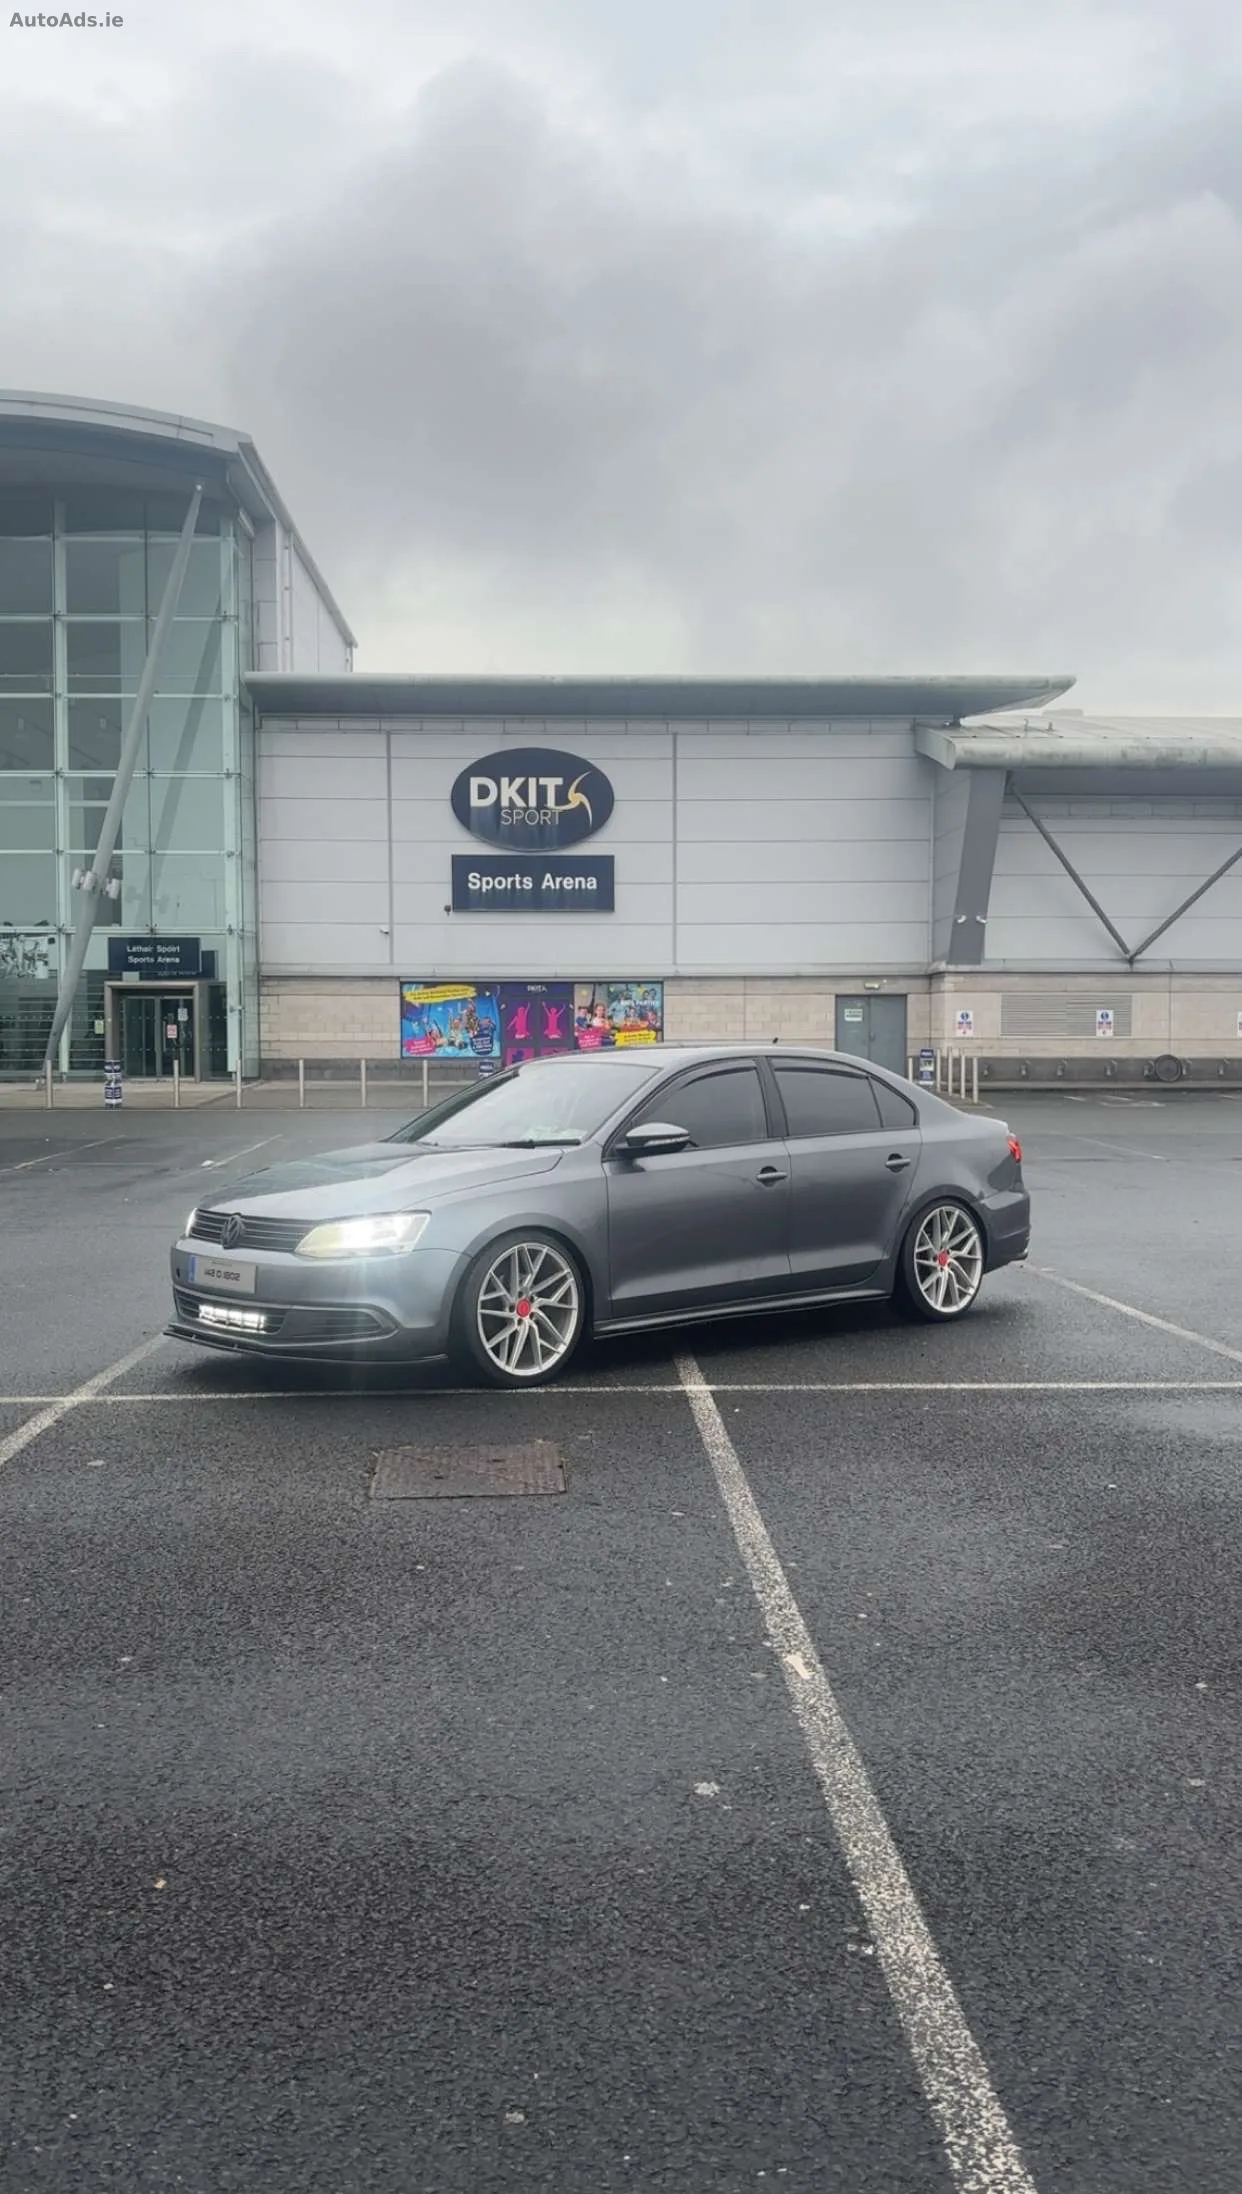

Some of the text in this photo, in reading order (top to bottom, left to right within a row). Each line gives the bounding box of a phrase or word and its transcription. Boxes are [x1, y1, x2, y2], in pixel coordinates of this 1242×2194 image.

[469, 776, 564, 808] DKIT
[500, 809, 561, 826] SPORT
[467, 872, 598, 893] Sports Arena
[127, 955, 155, 964] Sports
